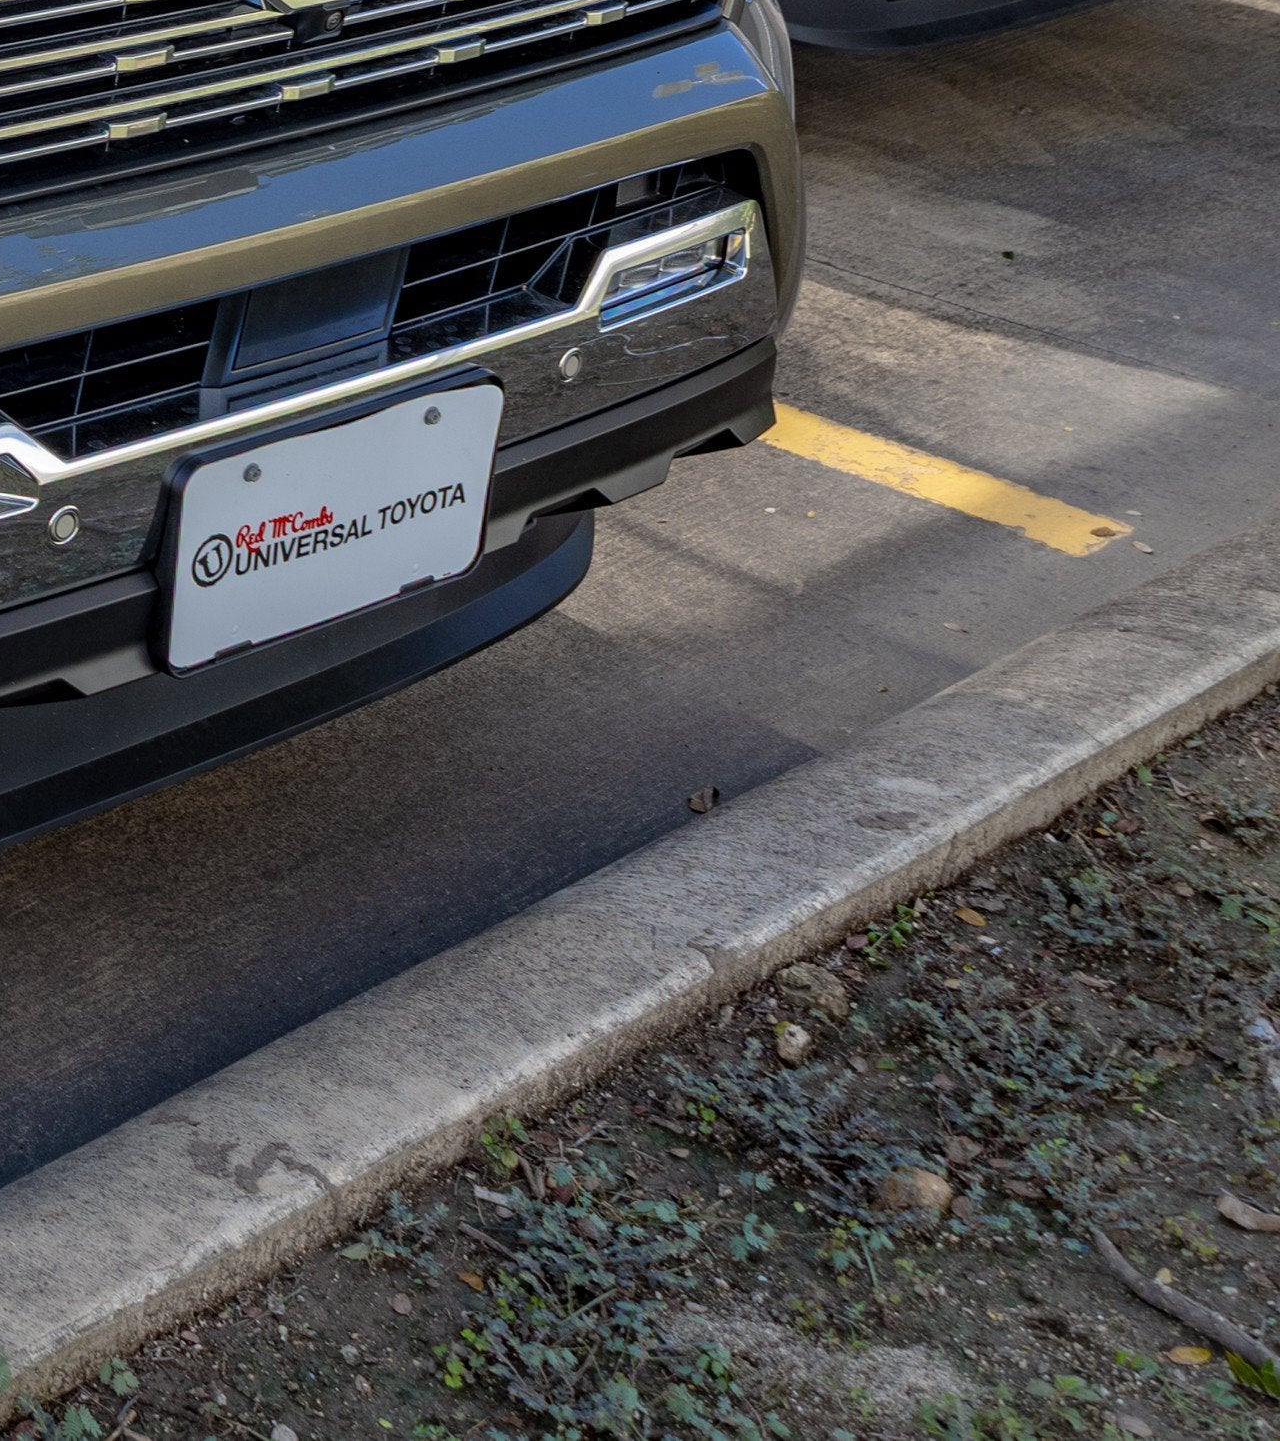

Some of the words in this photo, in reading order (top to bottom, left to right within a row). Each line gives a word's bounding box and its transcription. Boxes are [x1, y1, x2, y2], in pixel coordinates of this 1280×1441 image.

[235, 515, 372, 576] UNIVERSAL
[378, 482, 466, 530] TOYOTA
[236, 521, 266, 553] Red
[269, 506, 334, 539] McCombs
